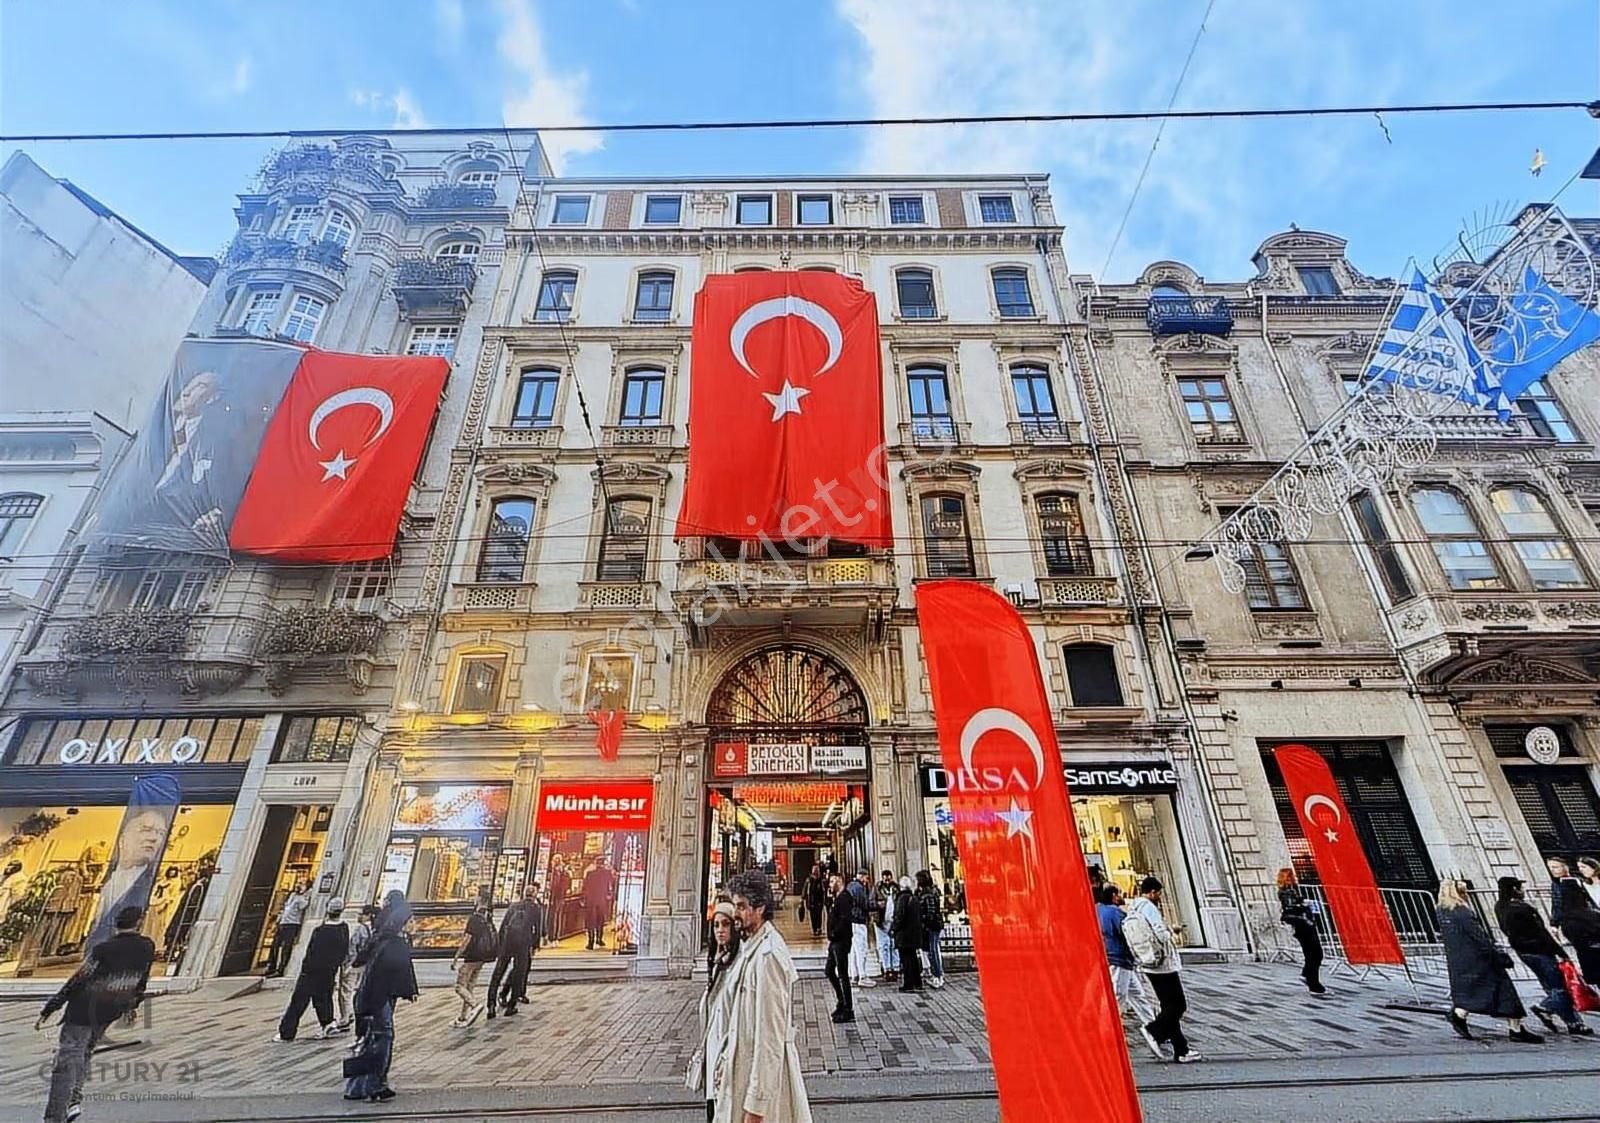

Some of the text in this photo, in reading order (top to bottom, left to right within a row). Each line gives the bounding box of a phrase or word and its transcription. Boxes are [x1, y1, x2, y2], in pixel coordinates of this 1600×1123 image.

[60, 737, 200, 765] OXXO
[751, 745, 804, 759] BEYOĞLU
[929, 767, 1030, 792] DESA
[1064, 768, 1176, 788] Samsonite
[545, 795, 647, 811] Münhasır
